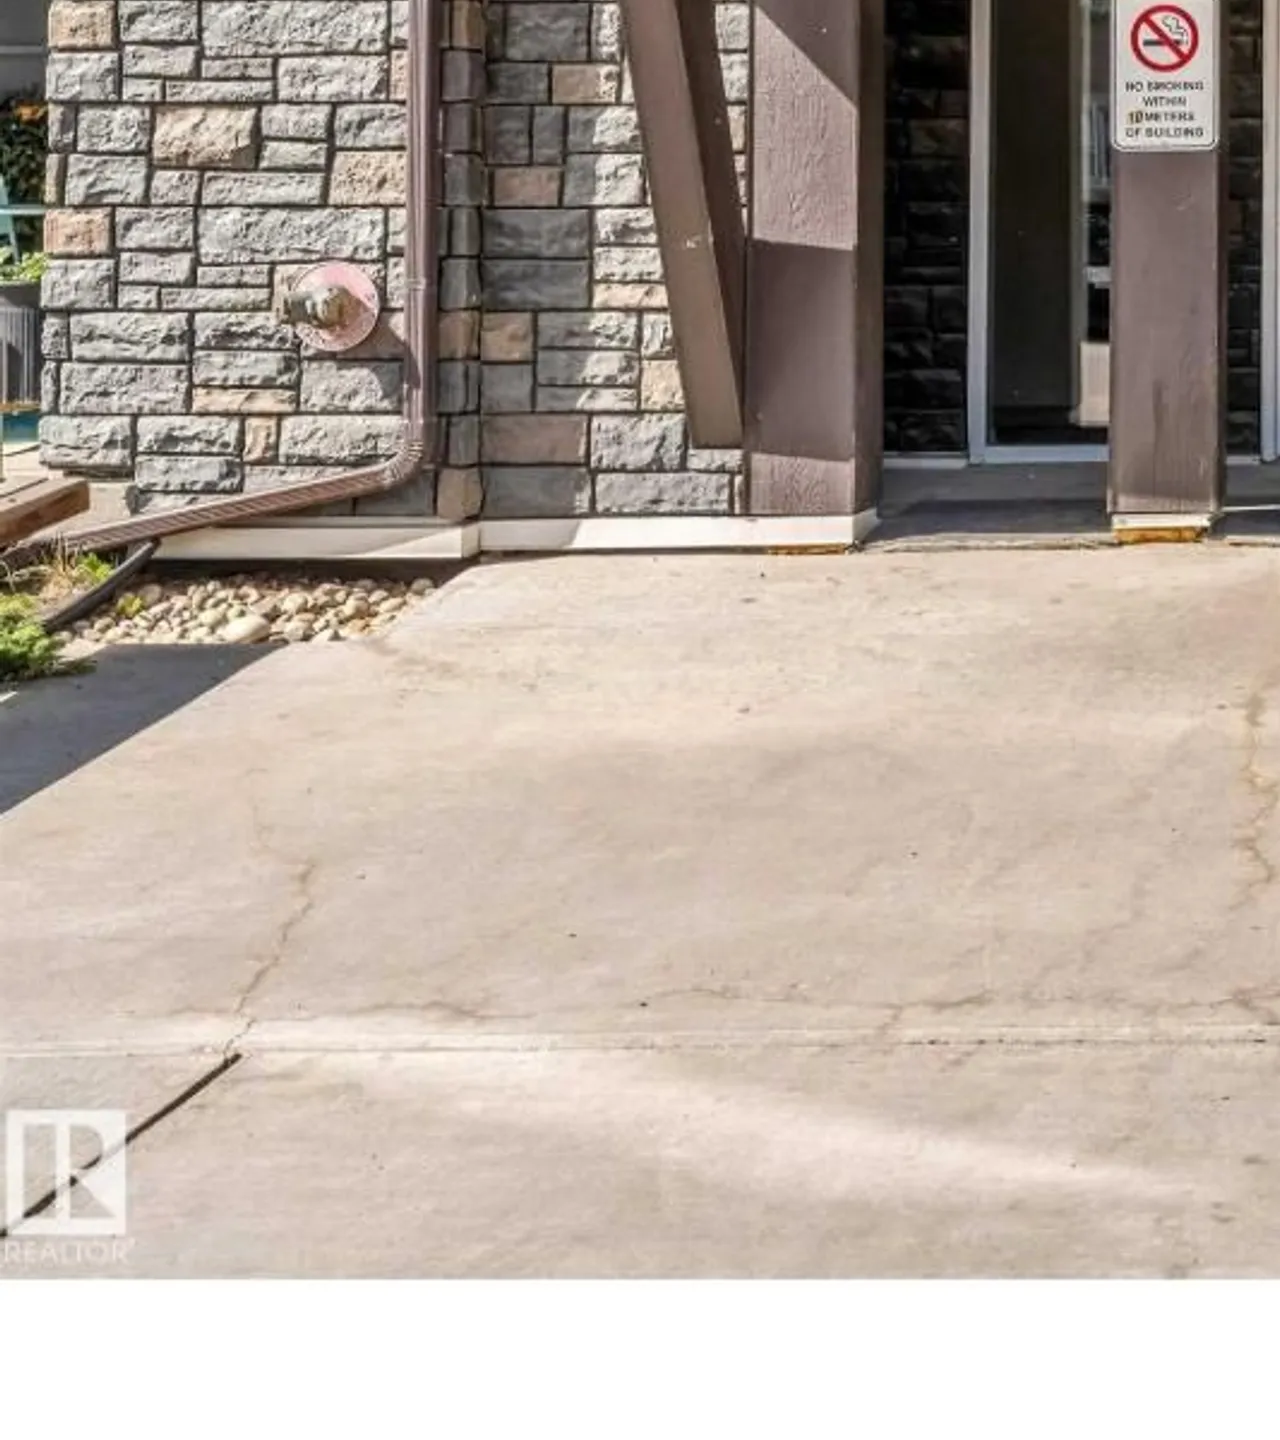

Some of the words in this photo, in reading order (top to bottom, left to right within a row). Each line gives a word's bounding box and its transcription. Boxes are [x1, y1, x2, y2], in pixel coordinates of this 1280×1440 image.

[1125, 81, 1144, 92] NO
[1147, 81, 1204, 92] SMOKING
[1142, 96, 1187, 107] WITHIN
[1145, 111, 1194, 122] METERS
[1125, 127, 1141, 138] OF
[1145, 127, 1204, 138] BUILDING
